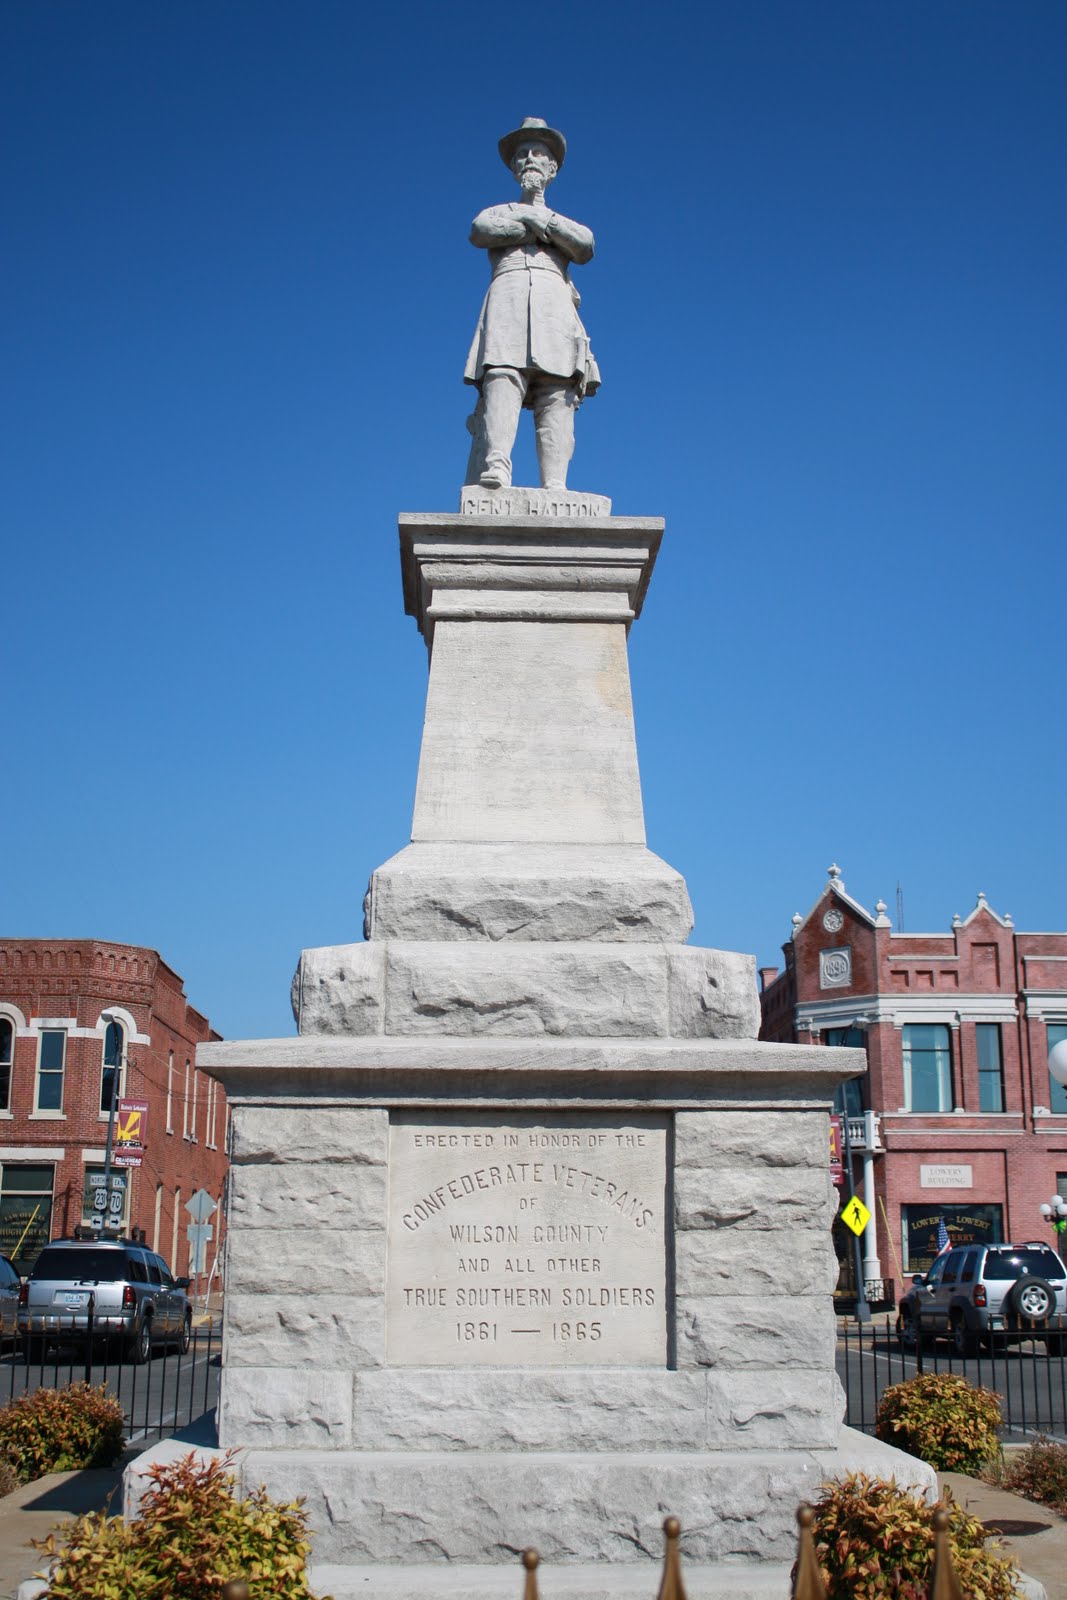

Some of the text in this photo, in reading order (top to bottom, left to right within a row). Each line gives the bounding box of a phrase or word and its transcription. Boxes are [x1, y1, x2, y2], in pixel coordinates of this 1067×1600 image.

[527, 499, 601, 517] HATTON
[414, 1134, 646, 1147] ERECTED IN HONOR OF THE
[112, 1195, 120, 1208] 70
[402, 1163, 654, 1231] CONFEDERATE VETERANS
[519, 1198, 538, 1210] OF
[956, 1216, 991, 1230] LOWERY
[450, 1225, 608, 1243] WILSON COUNTY
[458, 1258, 601, 1273] AND ALL OTHER
[403, 1288, 655, 1307] TRUE SOUTHERN SOLDIERS
[456, 1322, 498, 1341] 1861
[552, 1322, 602, 1341] 1865
